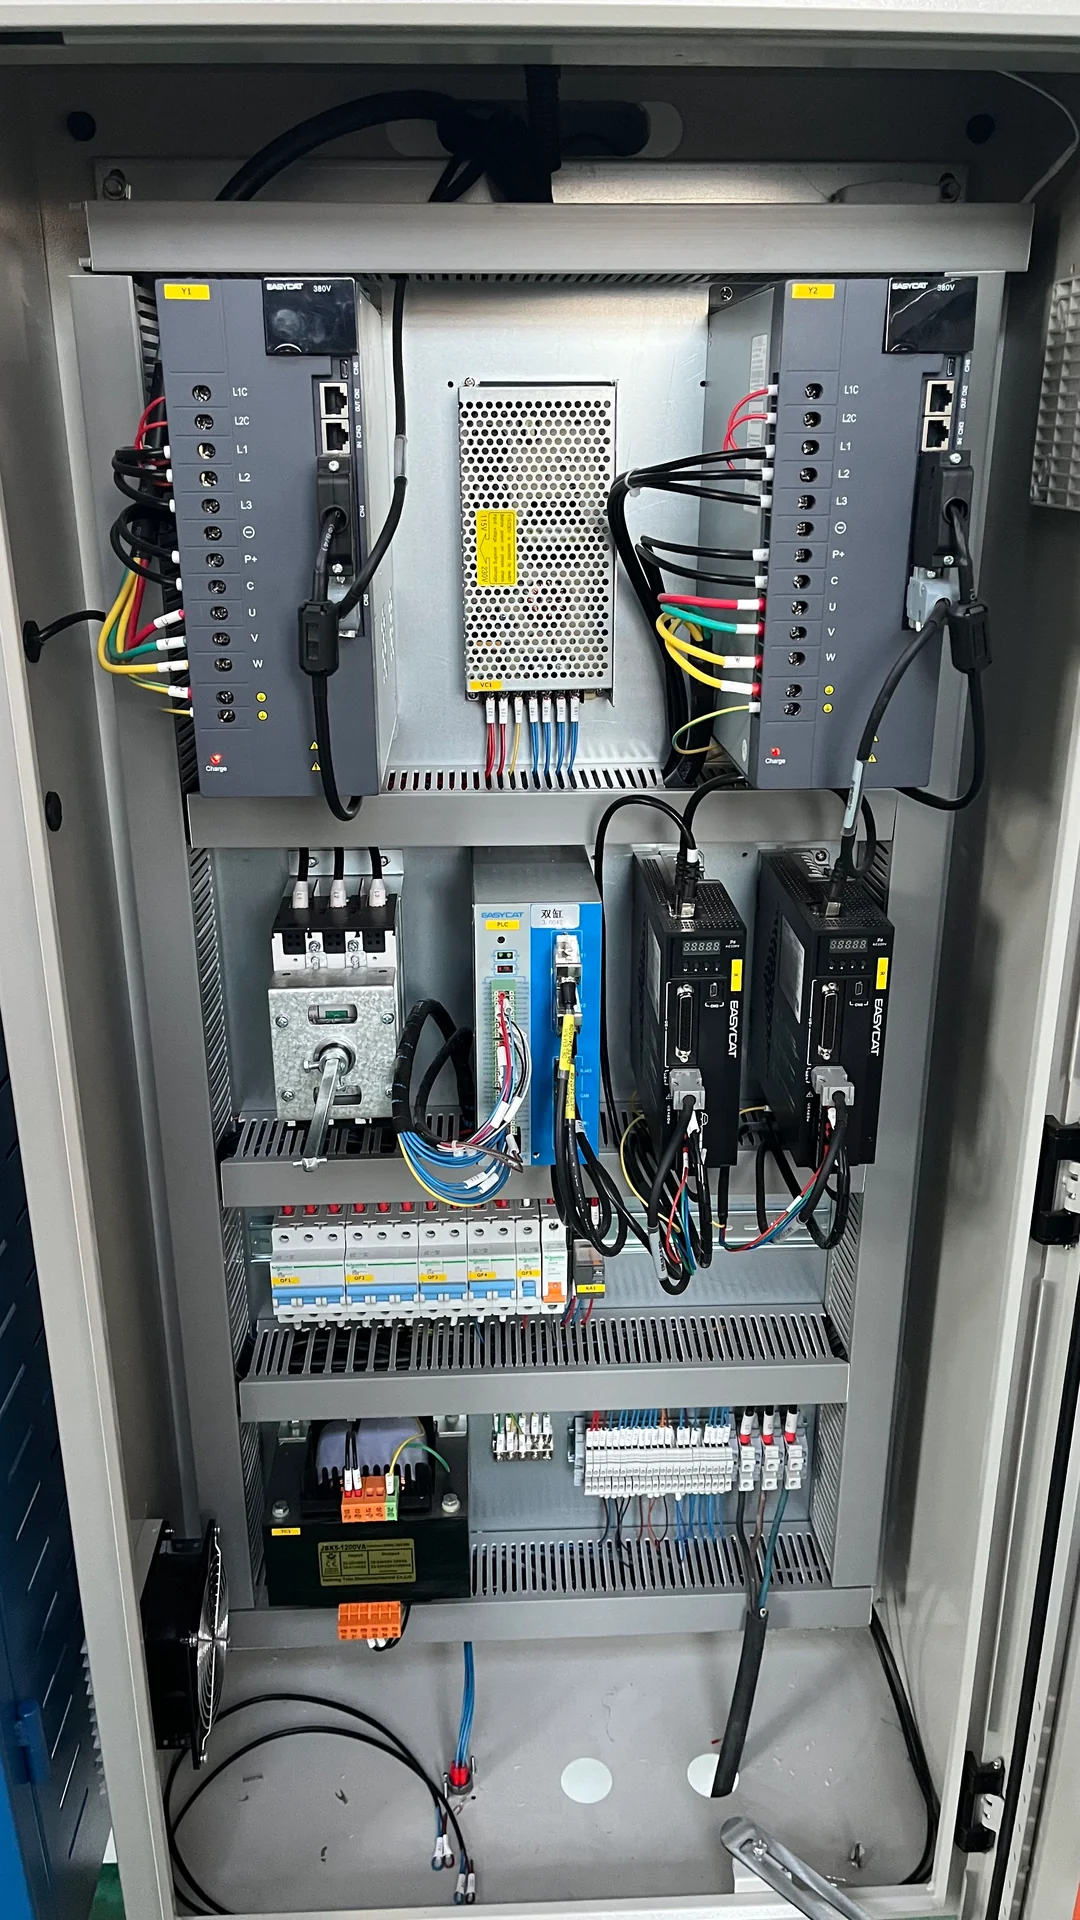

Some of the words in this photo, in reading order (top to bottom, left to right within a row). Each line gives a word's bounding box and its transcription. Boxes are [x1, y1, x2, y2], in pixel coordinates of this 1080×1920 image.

[232, 387, 248, 397] L1C
[844, 385, 859, 395] L1C
[235, 416, 250, 426] L2C
[842, 414, 857, 423] L2C
[236, 445, 248, 454] L1
[840, 442, 851, 451] L1
[238, 473, 251, 482] L2
[838, 470, 850, 479] L2
[240, 501, 252, 510] L3
[836, 497, 847, 506] L3
[832, 550, 845, 559] P+
[245, 555, 257, 564] P+
[831, 576, 838, 585] C
[246, 582, 254, 591] C
[829, 602, 836, 611] U
[249, 608, 256, 617] U
[828, 628, 835, 636] V
[251, 634, 259, 642] V
[826, 653, 836, 662] W
[252, 660, 263, 668] W
[765, 757, 786, 765] Charge
[206, 765, 227, 773] Charge
[541, 909, 563, 919] 双缸
[728, 1000, 739, 1058] EASYCAT
[870, 998, 883, 1056] EASYCAT
